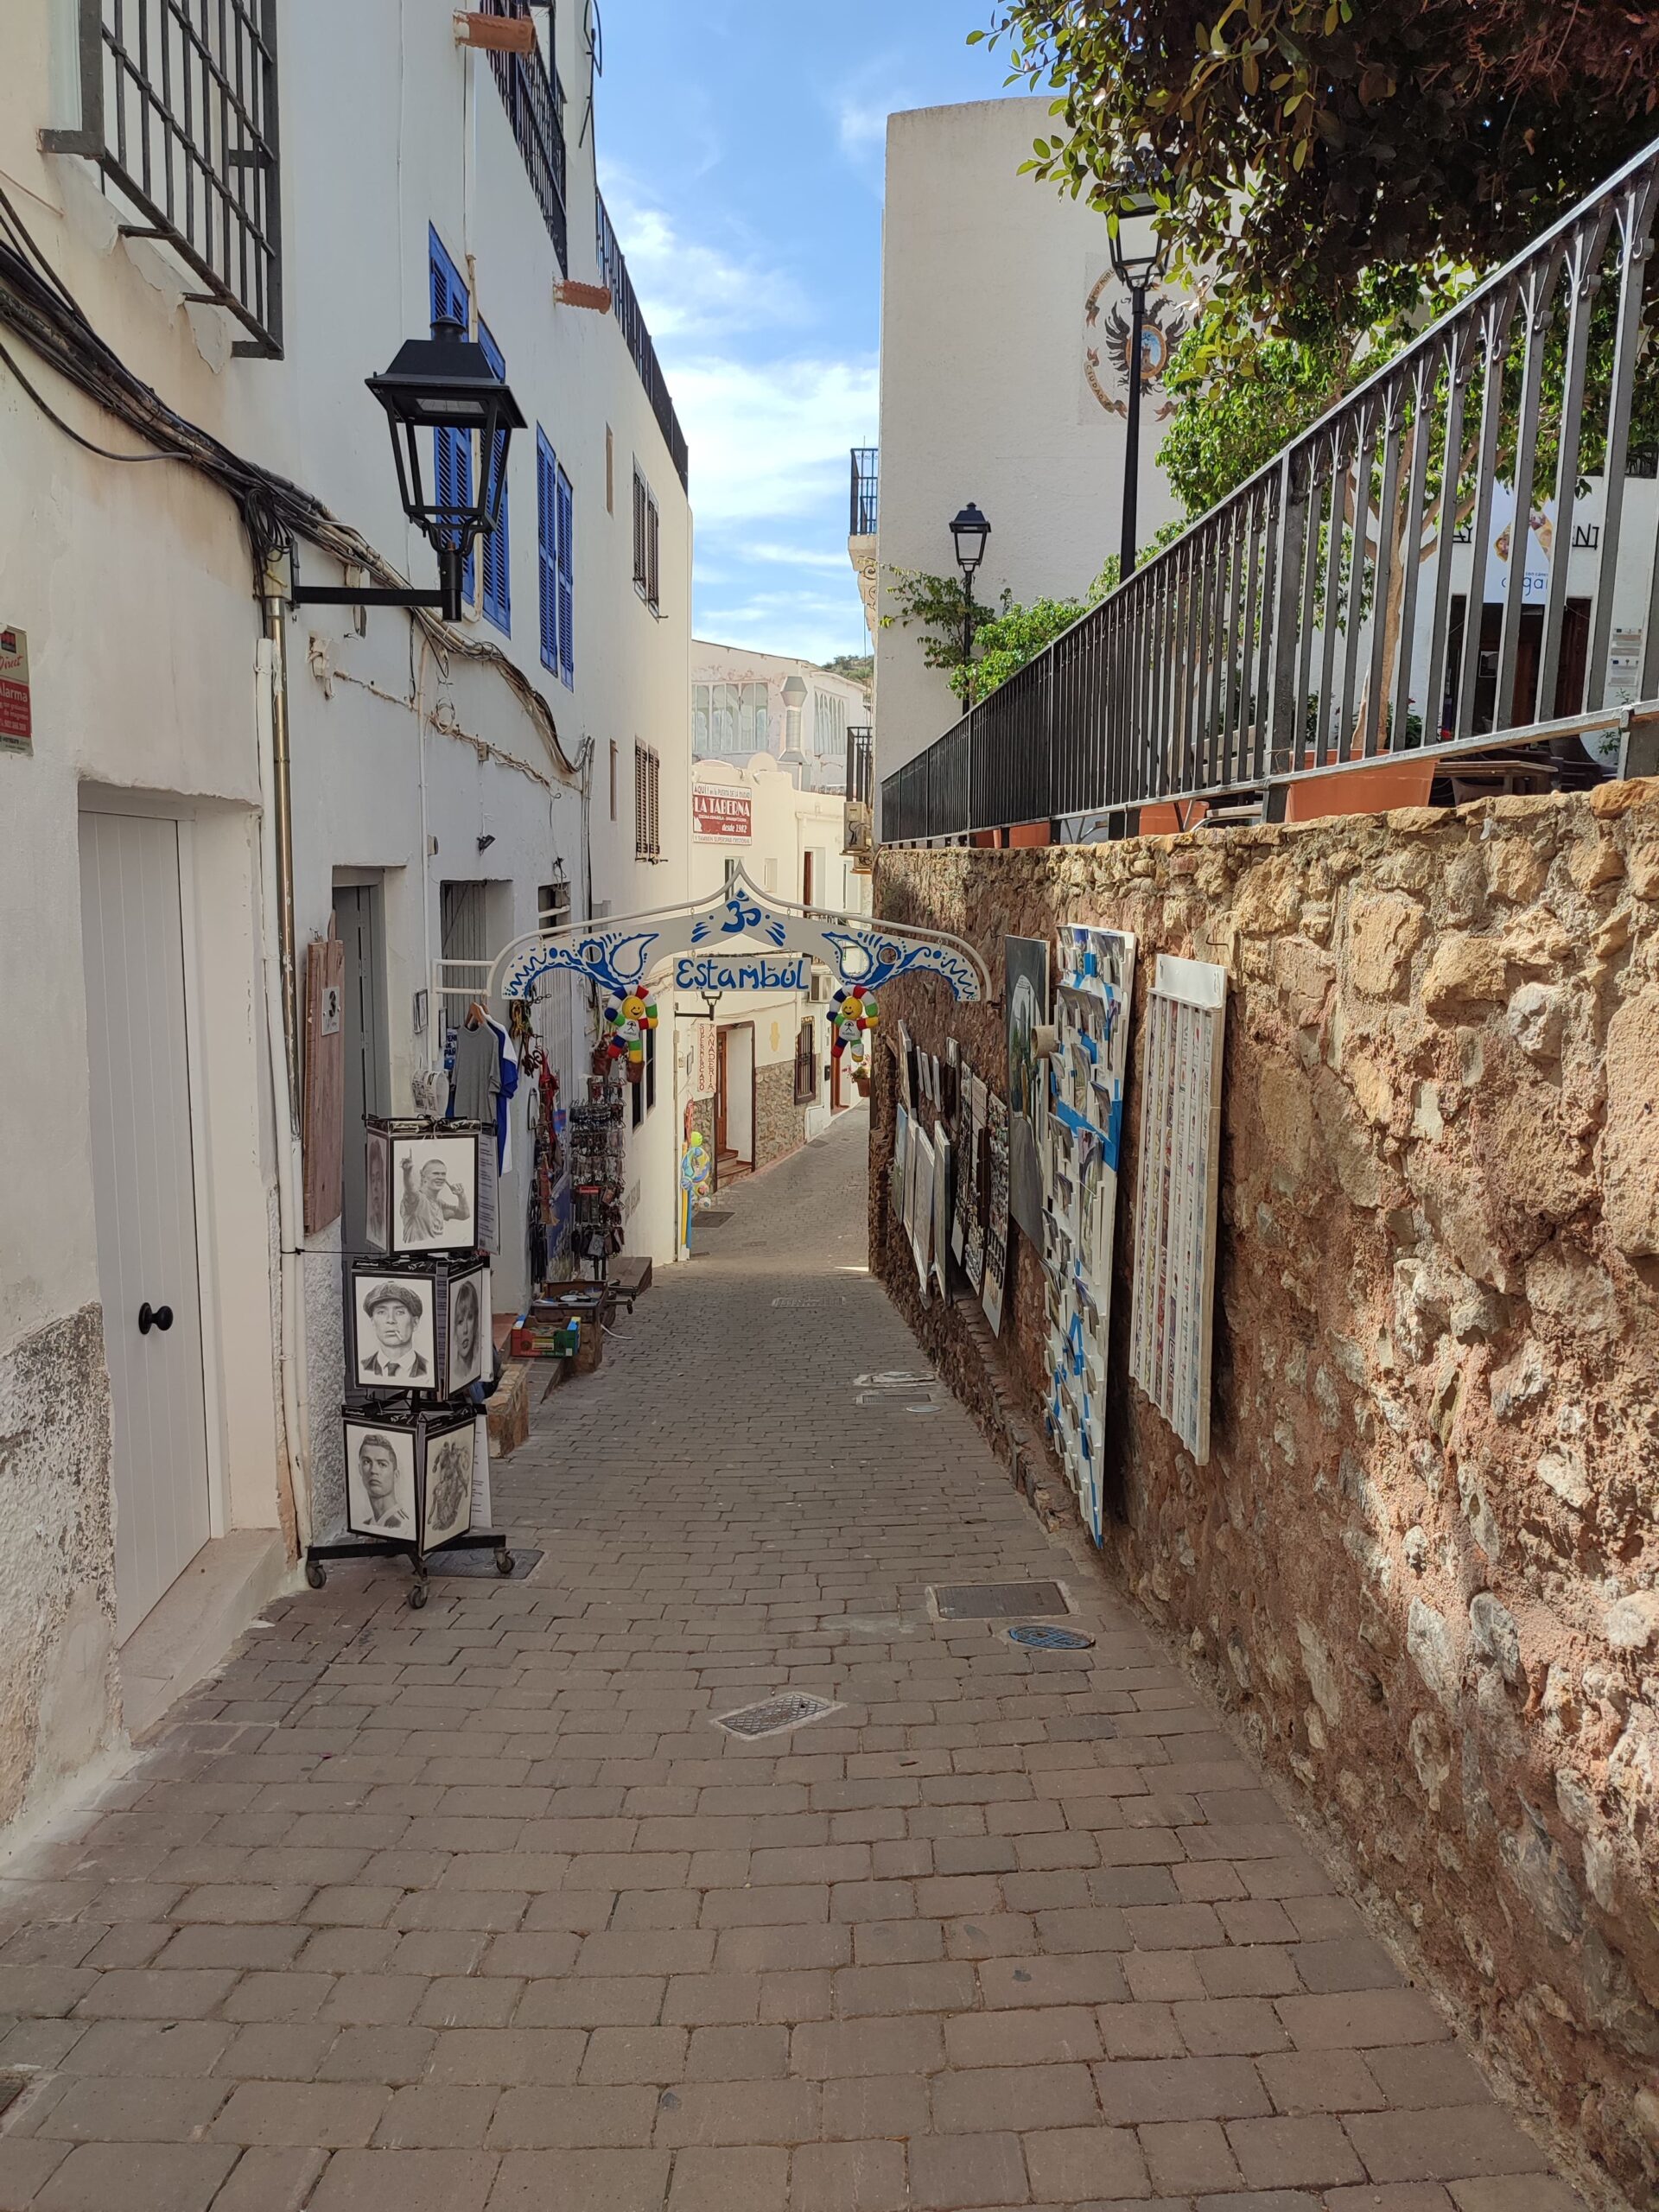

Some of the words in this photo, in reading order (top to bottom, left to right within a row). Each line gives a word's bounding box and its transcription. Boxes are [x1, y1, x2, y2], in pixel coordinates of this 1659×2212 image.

[694, 797, 708, 813] LA
[709, 798, 750, 817] TABERNA
[721, 823, 734, 832] desde
